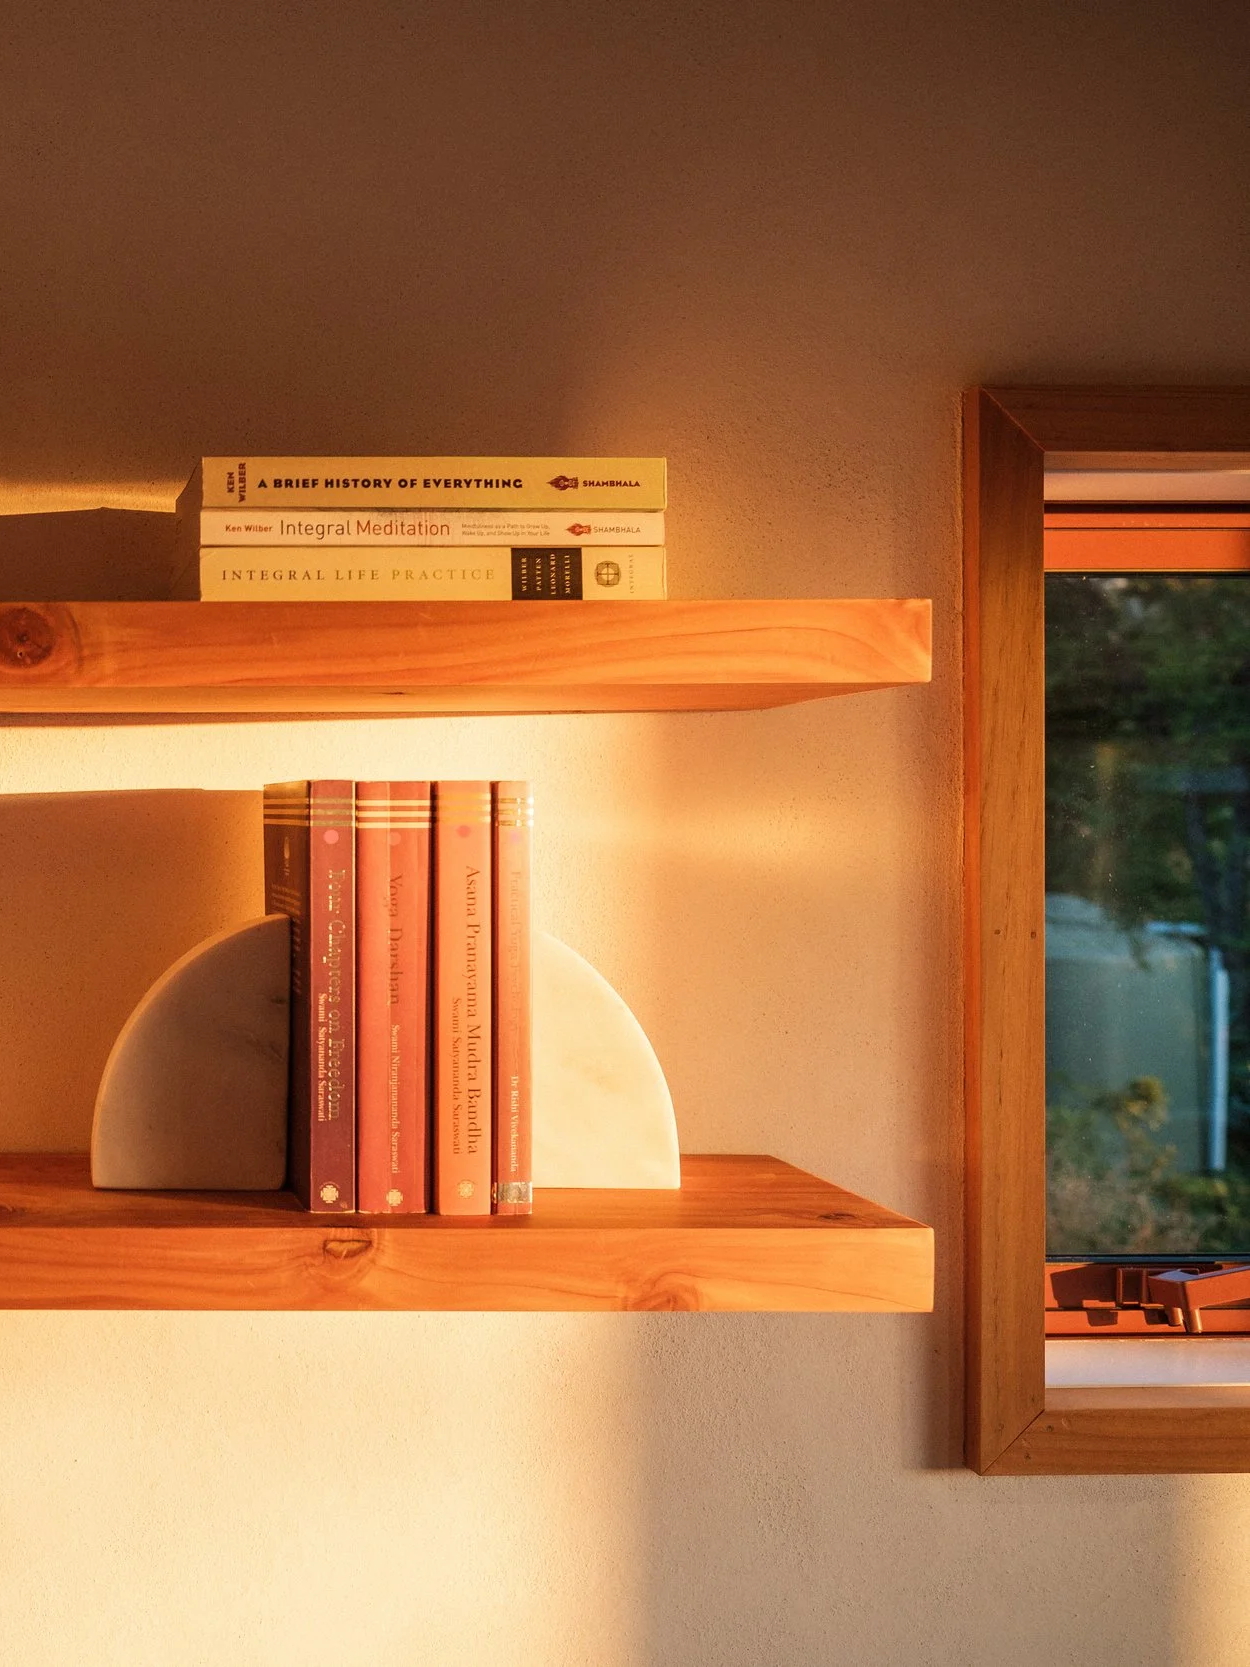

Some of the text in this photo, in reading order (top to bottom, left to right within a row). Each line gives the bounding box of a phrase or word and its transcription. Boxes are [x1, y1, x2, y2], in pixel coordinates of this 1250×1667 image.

[227, 471, 235, 493] KEN
[238, 462, 246, 503] WILBER
[257, 478, 523, 489] A BRIEF HISTORY OF EVERYTHING
[582, 480, 640, 488] SHAMBHALA
[225, 519, 450, 540] Ken Wilber Integral Meditation
[593, 526, 641, 534] SHAMBHALA
[222, 569, 494, 581] INTEGRAL LIFE PRACTICE
[383, 873, 403, 1005] Yoga Darshan
[322, 869, 346, 1121] Four Chapters on Freedom
[461, 865, 482, 1155] Asana Pranayama Mudra Bandha
[391, 1024, 400, 1053] Swami
[316, 993, 327, 1121] Swami Satyananda Saraswati
[450, 997, 463, 1155] Swami Satyananda Saraswati
[511, 1075, 519, 1088] Dr
[511, 1090, 519, 1113] Rishi
[391, 1131, 400, 1173] Saraswati
